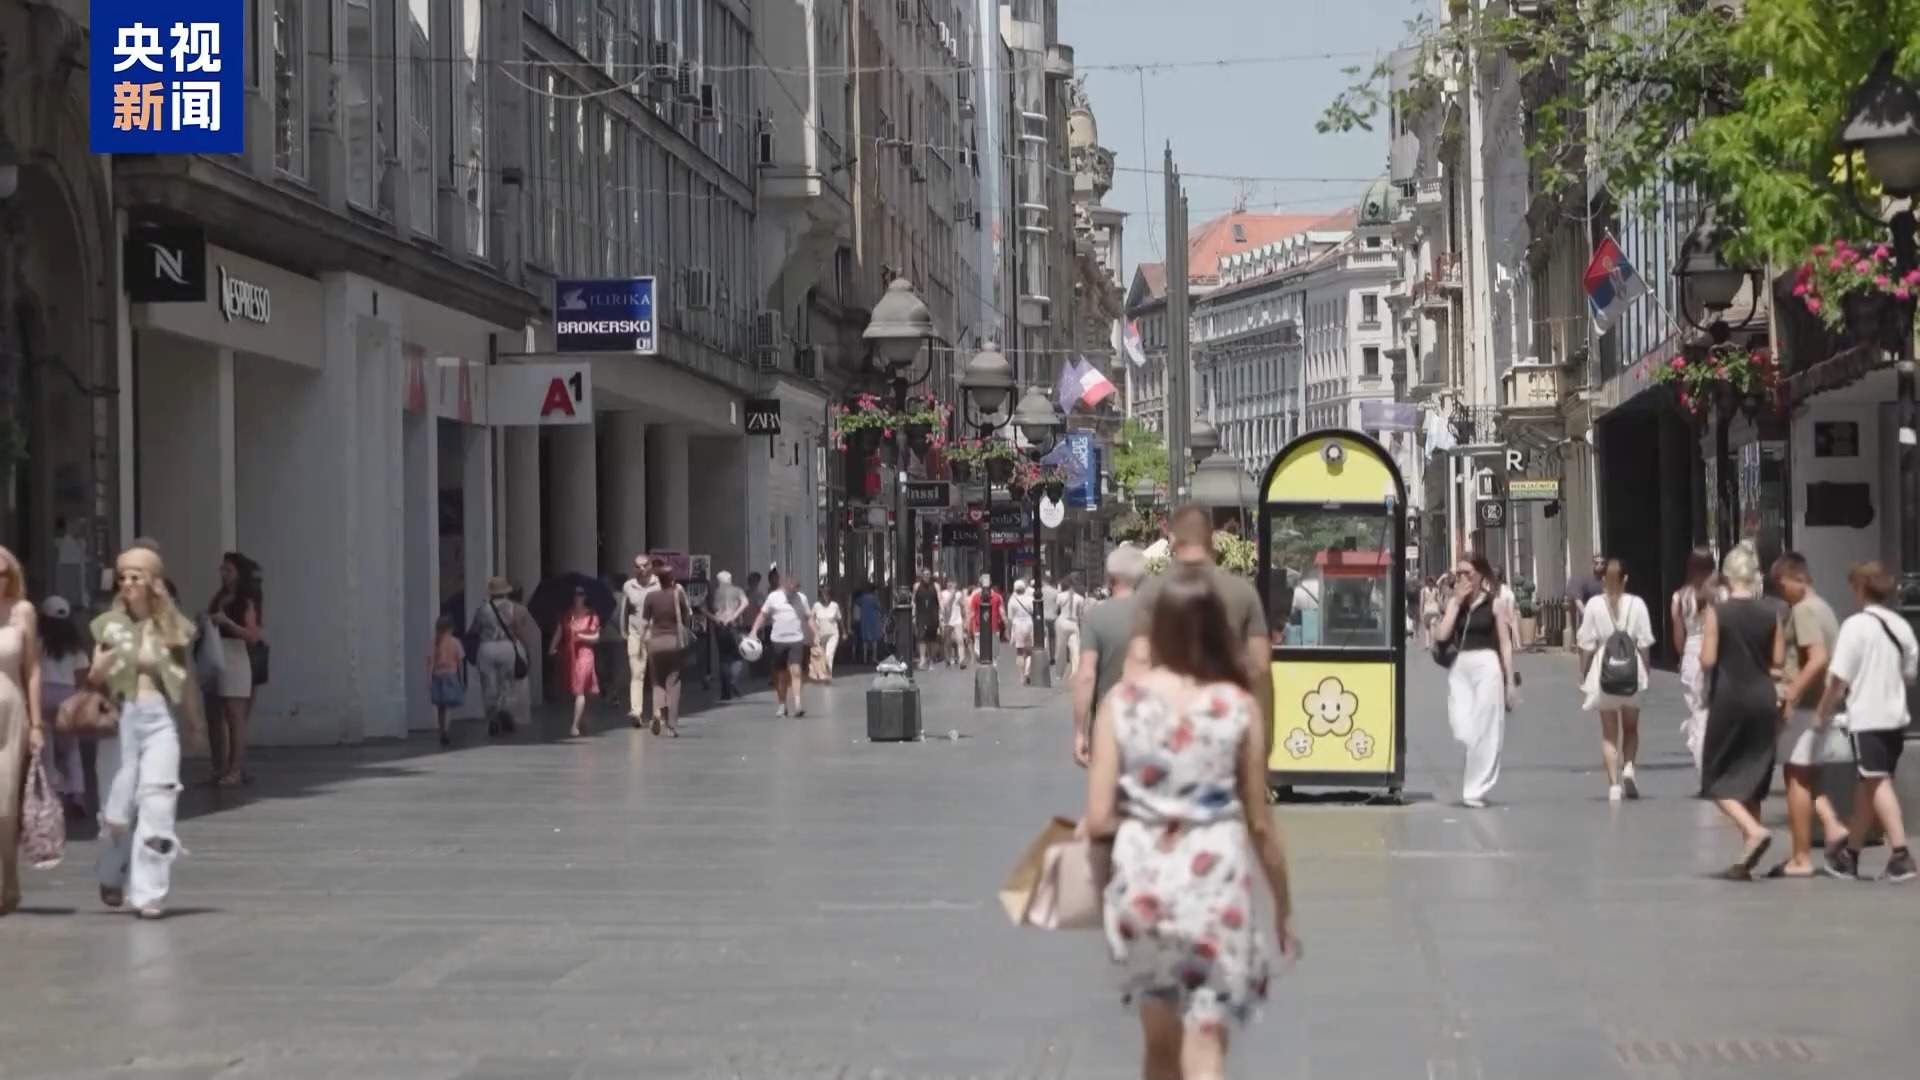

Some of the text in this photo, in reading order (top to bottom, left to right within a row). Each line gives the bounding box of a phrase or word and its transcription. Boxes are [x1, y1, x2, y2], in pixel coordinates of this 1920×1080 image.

[590, 294, 650, 305] ILIRIKA
[557, 320, 651, 334] BROKERSKO
[541, 371, 583, 417] A1
[748, 412, 780, 429] ZARA
[1506, 448, 1524, 471] R
